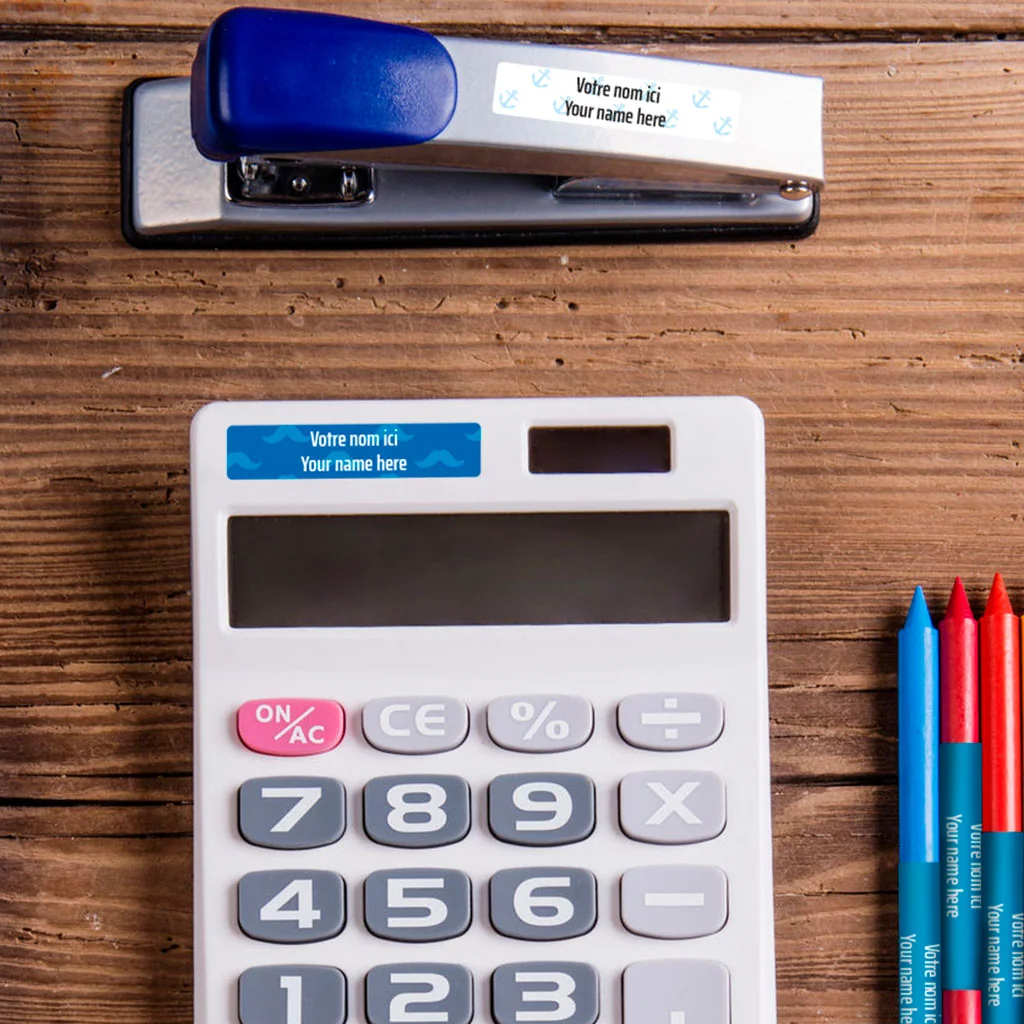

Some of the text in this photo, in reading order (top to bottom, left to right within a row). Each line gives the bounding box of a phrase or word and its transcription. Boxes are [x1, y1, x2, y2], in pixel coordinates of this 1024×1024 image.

[577, 77, 661, 104] Votre nom ici
[565, 100, 666, 128] Your name here
[310, 428, 398, 447] Votre nom ici
[300, 454, 407, 472] Your name here
[380, 704, 445, 736] CE
[261, 788, 322, 832] 7
[386, 783, 447, 833] 8
[512, 782, 572, 831] 9
[946, 814, 964, 918] Your name here
[260, 879, 321, 928] 4
[386, 878, 447, 927] 5
[513, 876, 574, 926] 6
[900, 934, 916, 964] Your
[924, 944, 940, 978] Votre
[988, 903, 1005, 1007] Your name here
[280, 976, 302, 1024] 1
[389, 973, 450, 1022] 2
[515, 972, 576, 1021] 3
[900, 967, 913, 1004] name
[924, 982, 936, 1011] nom
